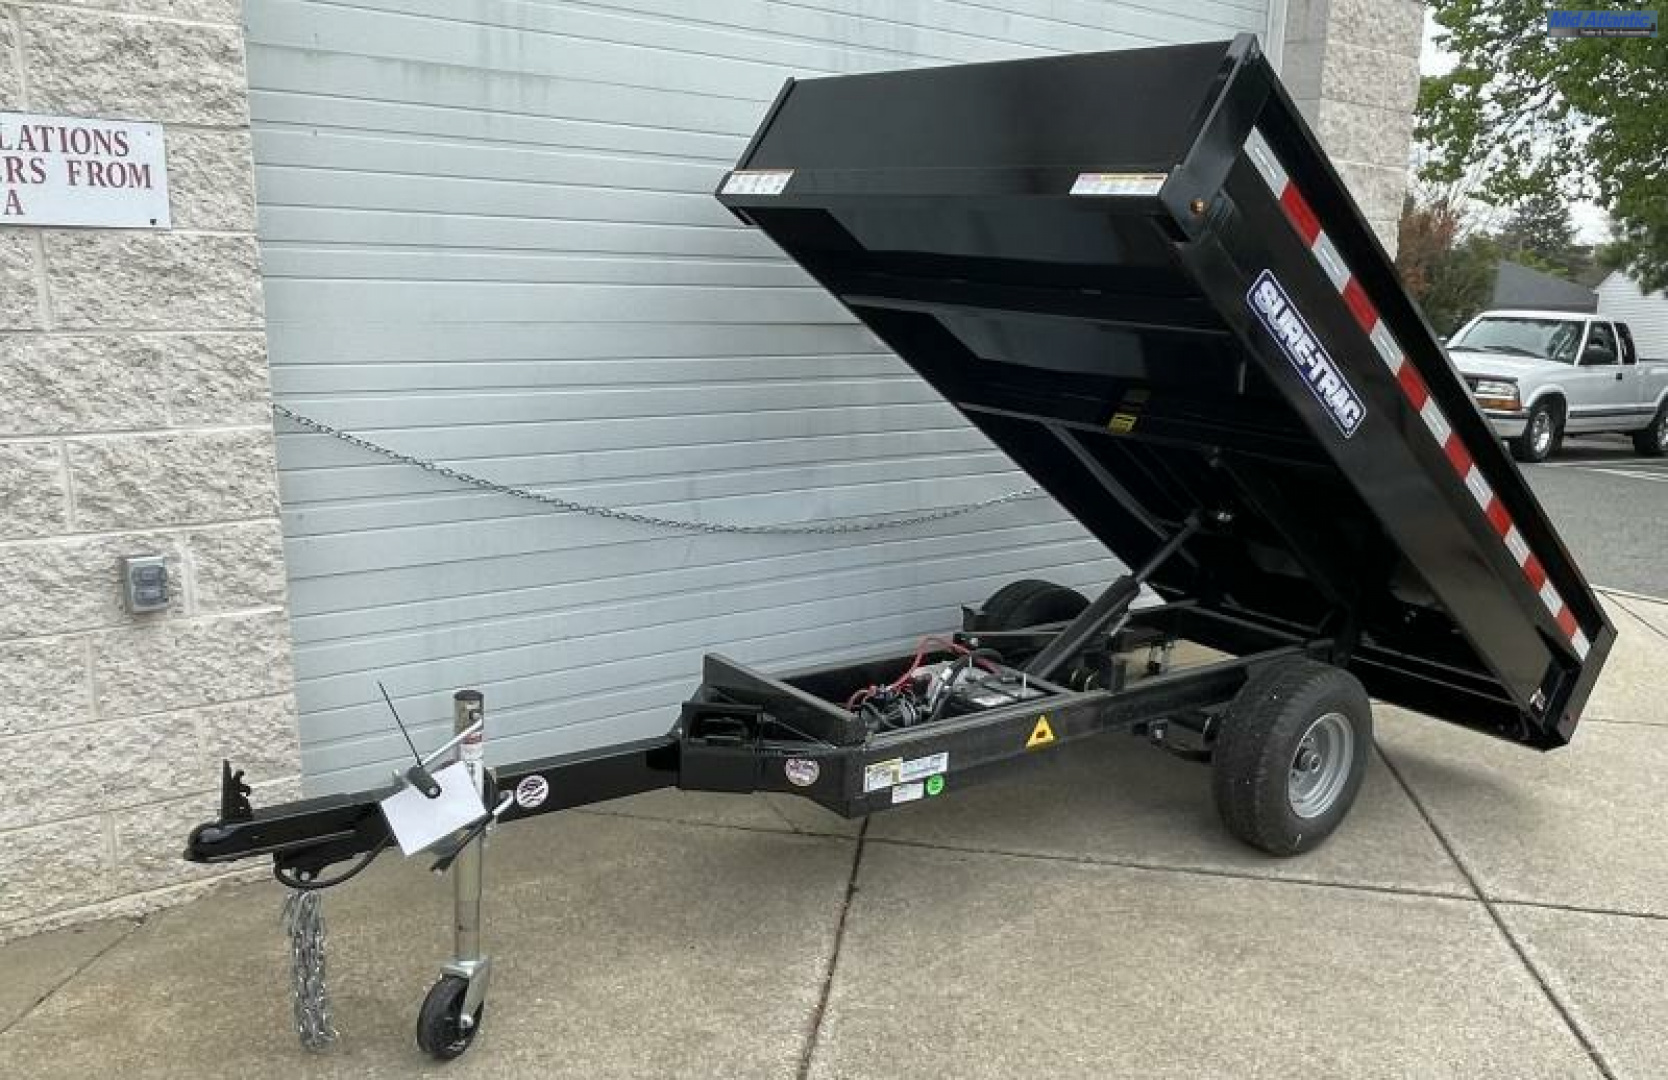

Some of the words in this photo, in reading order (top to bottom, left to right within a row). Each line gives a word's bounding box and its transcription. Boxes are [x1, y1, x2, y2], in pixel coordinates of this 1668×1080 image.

[0, 155, 47, 184] RS
[66, 159, 153, 189] FROM
[4, 189, 25, 215] A
[1254, 280, 1361, 428] SURE-TRAC
